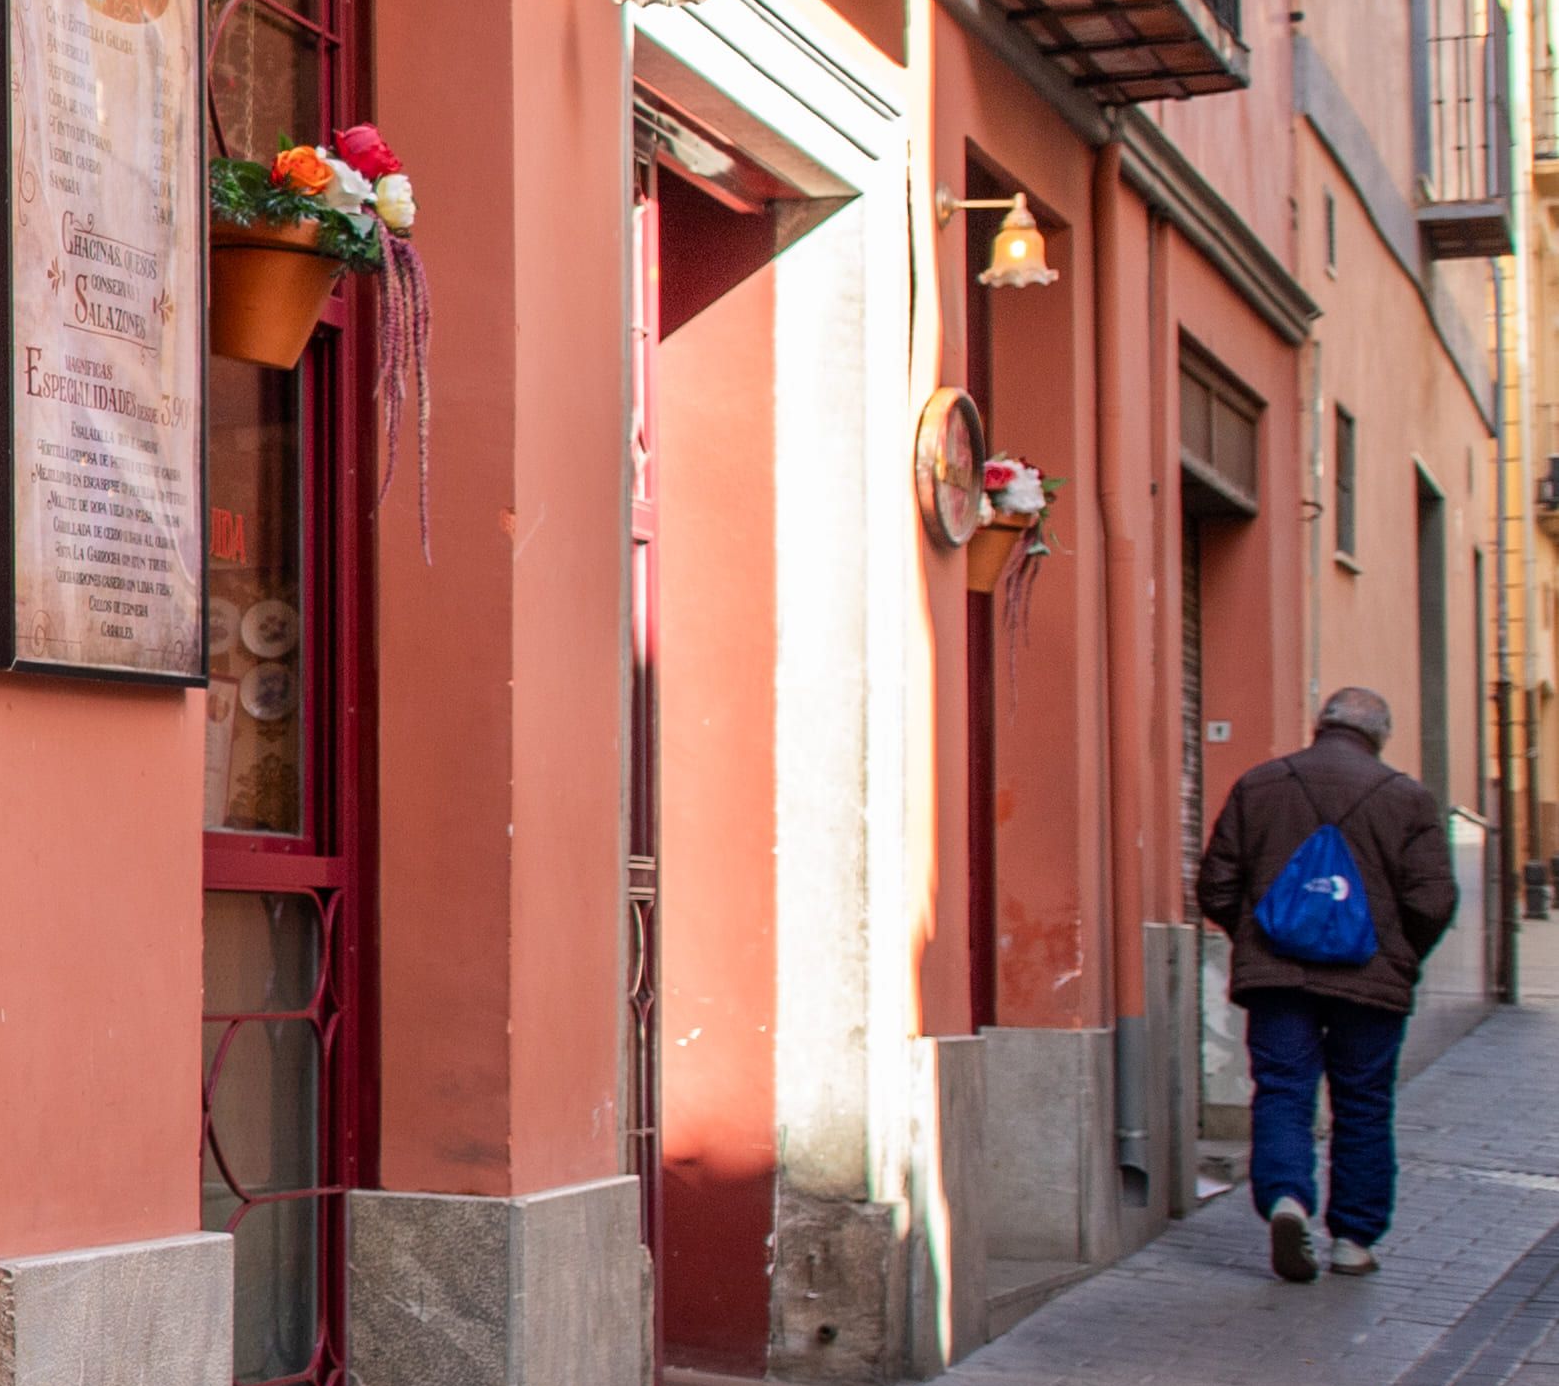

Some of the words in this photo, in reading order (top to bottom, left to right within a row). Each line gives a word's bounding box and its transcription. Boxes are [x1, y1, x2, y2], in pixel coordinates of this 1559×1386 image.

[124, 250, 156, 279] QUESOS
[75, 273, 146, 338] SALAZONES
[24, 346, 137, 417] ESPECIALIDADES
